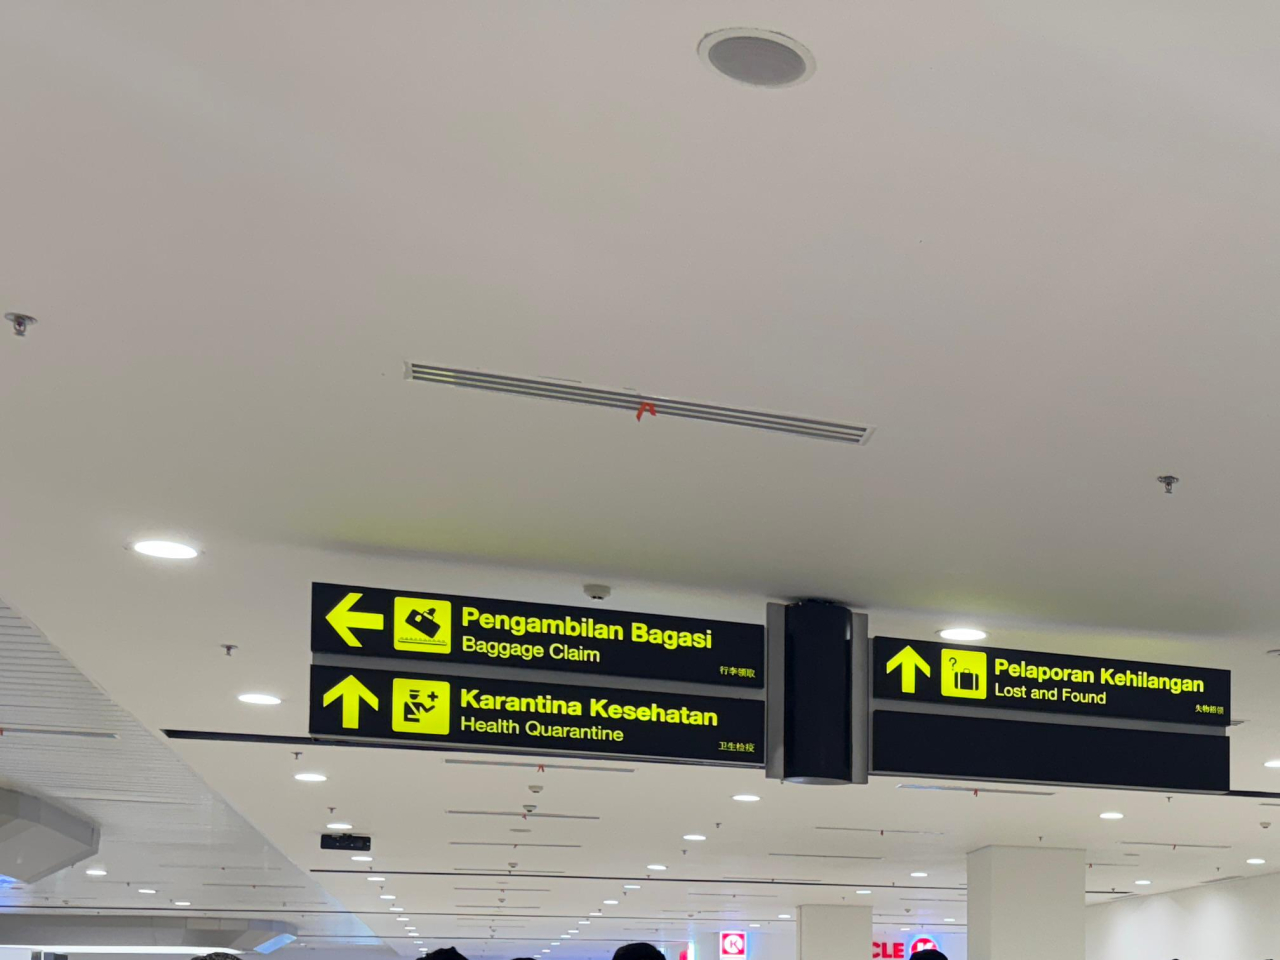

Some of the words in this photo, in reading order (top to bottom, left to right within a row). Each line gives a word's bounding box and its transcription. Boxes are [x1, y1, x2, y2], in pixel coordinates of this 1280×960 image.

[462, 606, 624, 641] Pengambilan
[631, 622, 712, 651] Bagasi
[462, 636, 544, 661] Baggage
[549, 643, 601, 662] Claim
[994, 659, 1095, 684] Pelaporan
[1100, 667, 1205, 694] Kehilangan
[461, 689, 583, 717] Karantina
[590, 699, 718, 727] Kesehatan
[995, 684, 1027, 699] Lost
[1031, 687, 1058, 701] and
[1062, 689, 1107, 705] Found
[461, 716, 520, 735] Health
[525, 720, 624, 742] Quarantine
